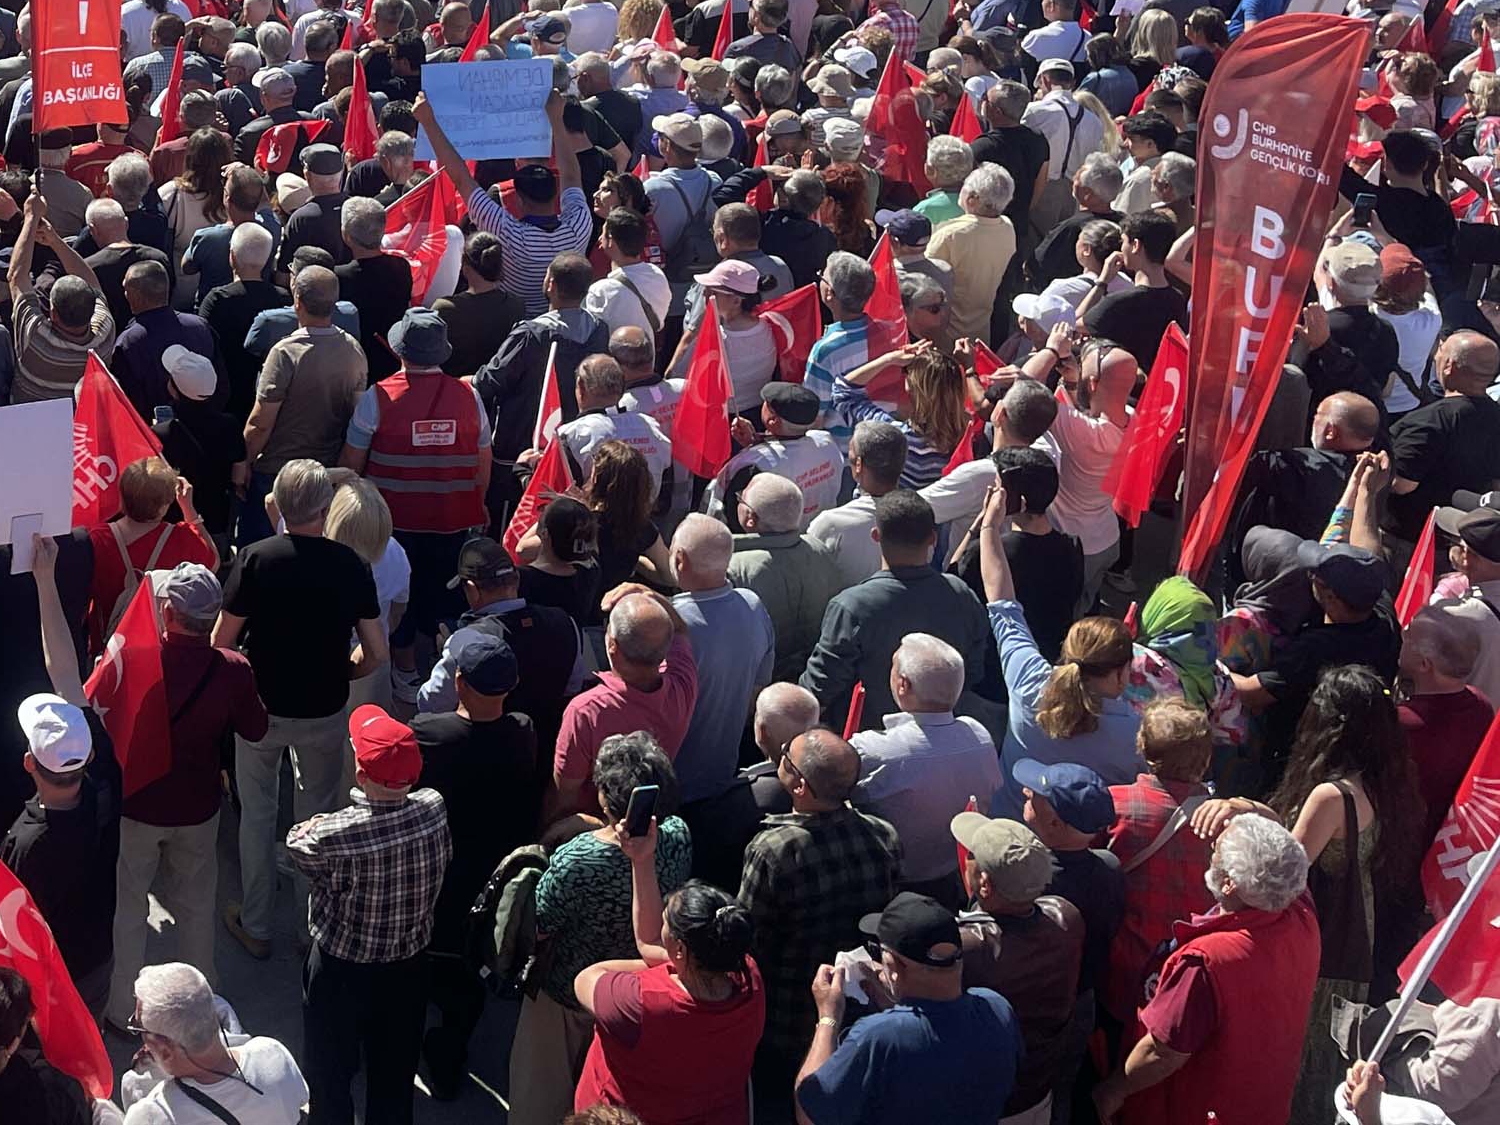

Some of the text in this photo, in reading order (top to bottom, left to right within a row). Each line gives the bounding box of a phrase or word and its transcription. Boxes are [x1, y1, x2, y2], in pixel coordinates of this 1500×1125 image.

[72, 61, 93, 80] İLÇE
[1252, 121, 1276, 135] CHP
[1252, 134, 1313, 162] BURHANİYE
[1250, 149, 1296, 174] GENÇLİK
[431, 423, 450, 431] CHP
